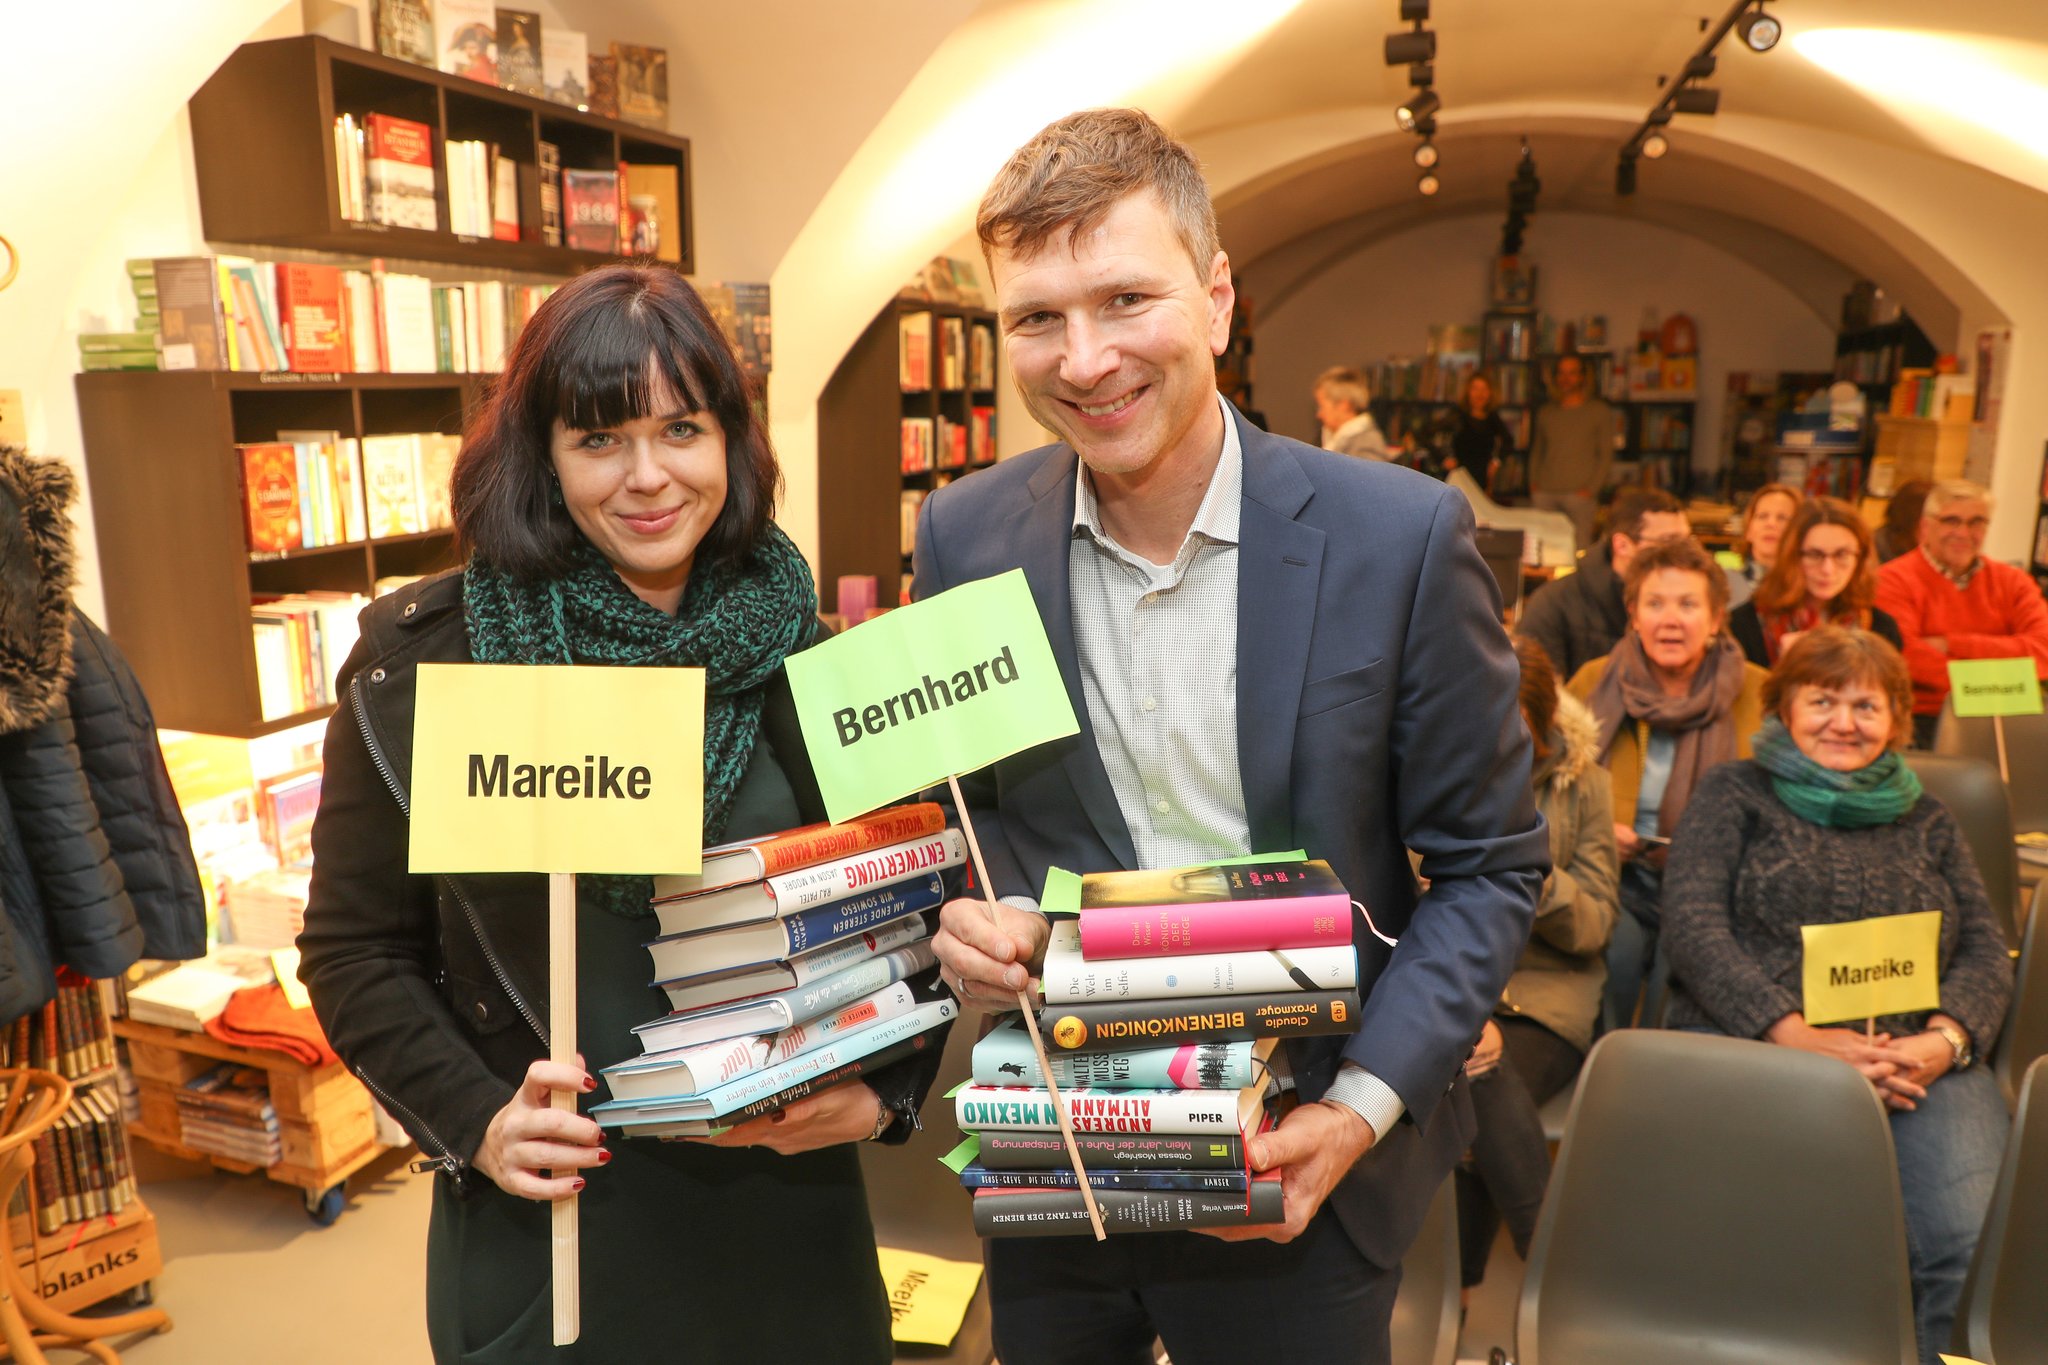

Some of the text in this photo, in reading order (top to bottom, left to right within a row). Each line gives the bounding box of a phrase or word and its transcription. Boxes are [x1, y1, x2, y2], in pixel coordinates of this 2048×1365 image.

[833, 645, 1020, 748] Bernhard
[466, 754, 652, 800] Mareike
[866, 821, 895, 844] HAAS
[895, 815, 924, 834] WOLF
[775, 830, 859, 868] JUNGER MANN
[817, 868, 838, 882] JASON
[843, 841, 946, 889] ENTWERTUNG
[782, 878, 808, 892] MOORE
[799, 887, 832, 905] RAJ PATEL
[840, 891, 895, 917] WIR SOWIESO
[893, 901, 906, 912] AM
[870, 906, 892, 921] ENDE
[790, 920, 801, 948] ADAM
[796, 914, 806, 951] SILVERA
[833, 914, 869, 935] STERBEN
[1132, 921, 1140, 946] Daniel
[1143, 920, 1151, 946] Wisser
[1161, 911, 1169, 952] KÖNIGIN
[1171, 922, 1180, 943] DER
[1182, 915, 1191, 947] BERGE
[1313, 917, 1321, 935] JUNG
[1213, 967, 1222, 990] Marco
[1331, 965, 1340, 977] SV
[1828, 957, 1915, 987] Mareike
[1069, 975, 1080, 996] Die
[1086, 973, 1097, 997] Welt
[1102, 977, 1113, 993] im
[1119, 969, 1129, 998] Selfie
[821, 1007, 874, 1032] JENNIFER CLEMENT
[1255, 1003, 1318, 1018] Praxmayer
[1265, 1014, 1309, 1027] Claudia
[1335, 1003, 1344, 1020] cbj
[872, 1018, 921, 1043] Oliver Scherz
[1095, 1011, 1245, 1040] BIENENKÖNIGIN
[725, 1051, 836, 1103] Ein Freund wie kein anderer
[1093, 1053, 1110, 1082] MUSS
[1113, 1058, 1130, 1081] WEG
[743, 1081, 811, 1116] Frida Kahlo
[1071, 1099, 1151, 1118] ALTMANN
[964, 1102, 1038, 1124] MEXIKO
[1188, 1112, 1223, 1123] PIPER
[1072, 1117, 1152, 1132] ANDREAS
[992, 1138, 1063, 1151] Entspannung
[1086, 1139, 1116, 1150] Ruhe
[1116, 1140, 1136, 1150] der
[1136, 1140, 1163, 1151] Jahr
[1164, 1140, 1192, 1150] Mein
[1113, 1150, 1192, 1161] Ottessa Moshfegh
[1028, 1175, 1039, 1184] DIE
[1040, 1175, 1057, 1184] ZIEGE
[1060, 1175, 1072, 1185] AUF
[1204, 1178, 1230, 1187] HANSER
[992, 1211, 1090, 1223] DER TANZ DER BIENEN
[1185, 1199, 1193, 1220] MUNZ
[1201, 1203, 1248, 1214] Czernin Verlag
[42, 1246, 139, 1300] blanks
